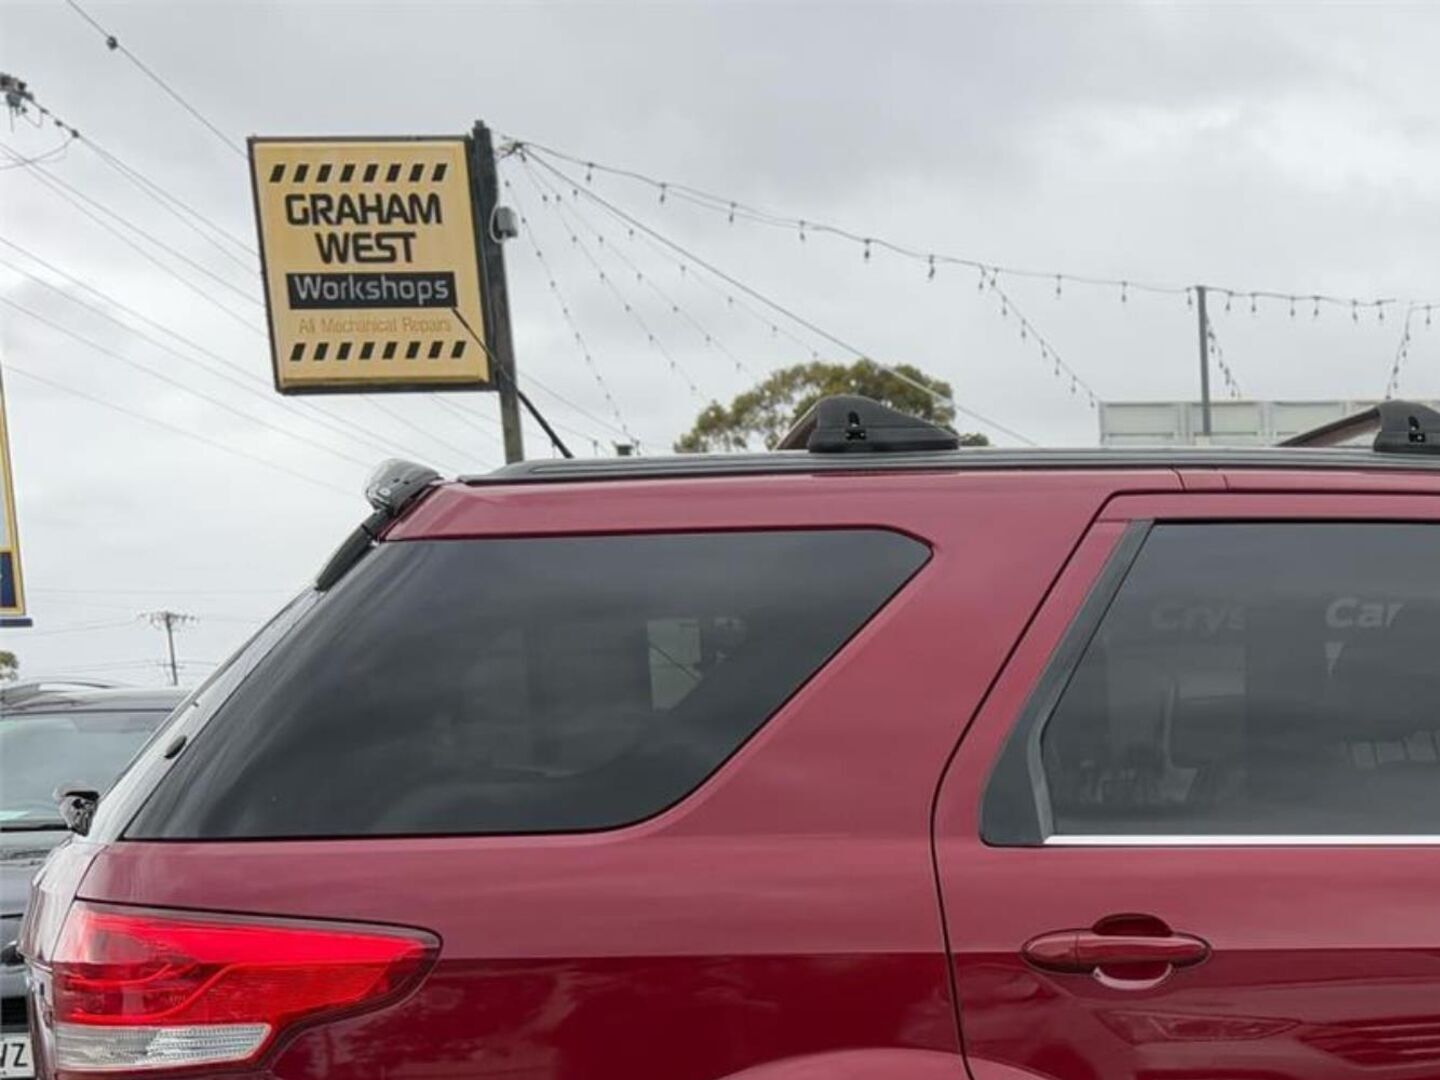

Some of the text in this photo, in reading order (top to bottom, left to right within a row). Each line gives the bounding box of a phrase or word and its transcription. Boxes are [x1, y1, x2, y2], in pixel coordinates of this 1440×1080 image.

[285, 192, 442, 227] GRAHAM
[315, 231, 417, 264] WEST
[294, 274, 449, 306] Workshops
